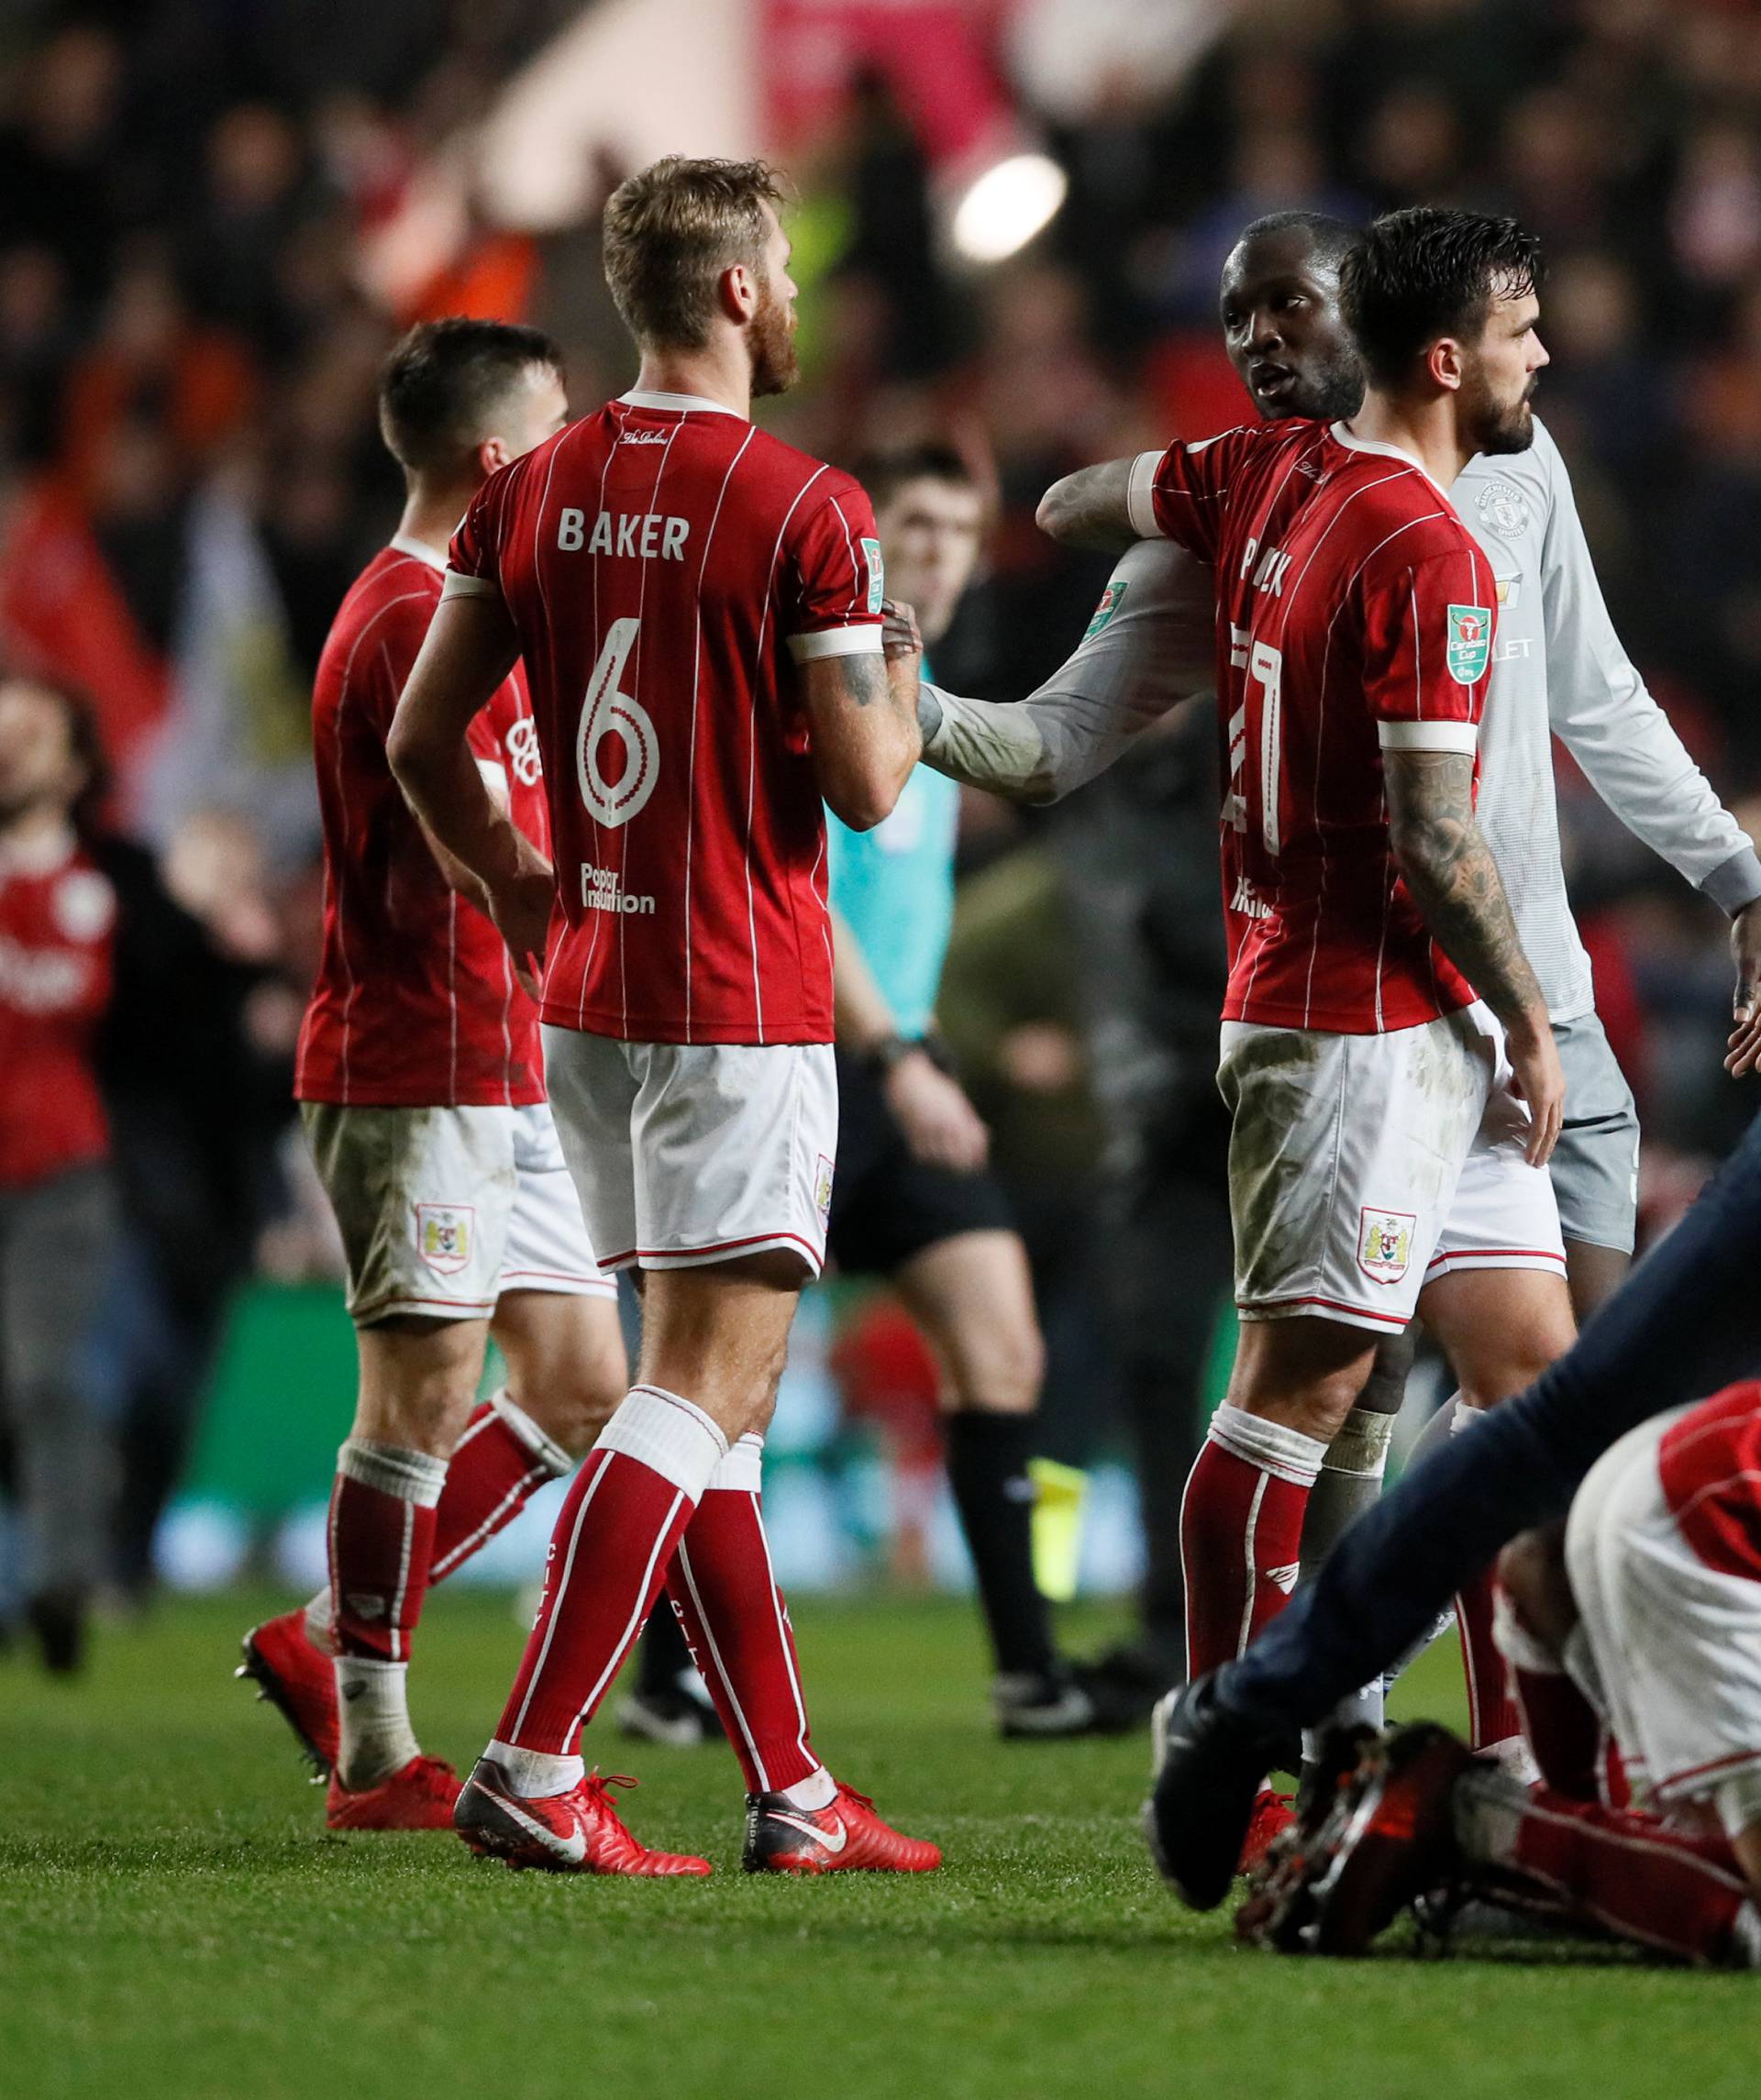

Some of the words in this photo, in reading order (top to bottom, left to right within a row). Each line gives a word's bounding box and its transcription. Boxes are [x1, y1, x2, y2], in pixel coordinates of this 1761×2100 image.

[558, 507, 690, 561] BAKER
[576, 617, 660, 829] 6
[533, 1543, 557, 1630] CITY
